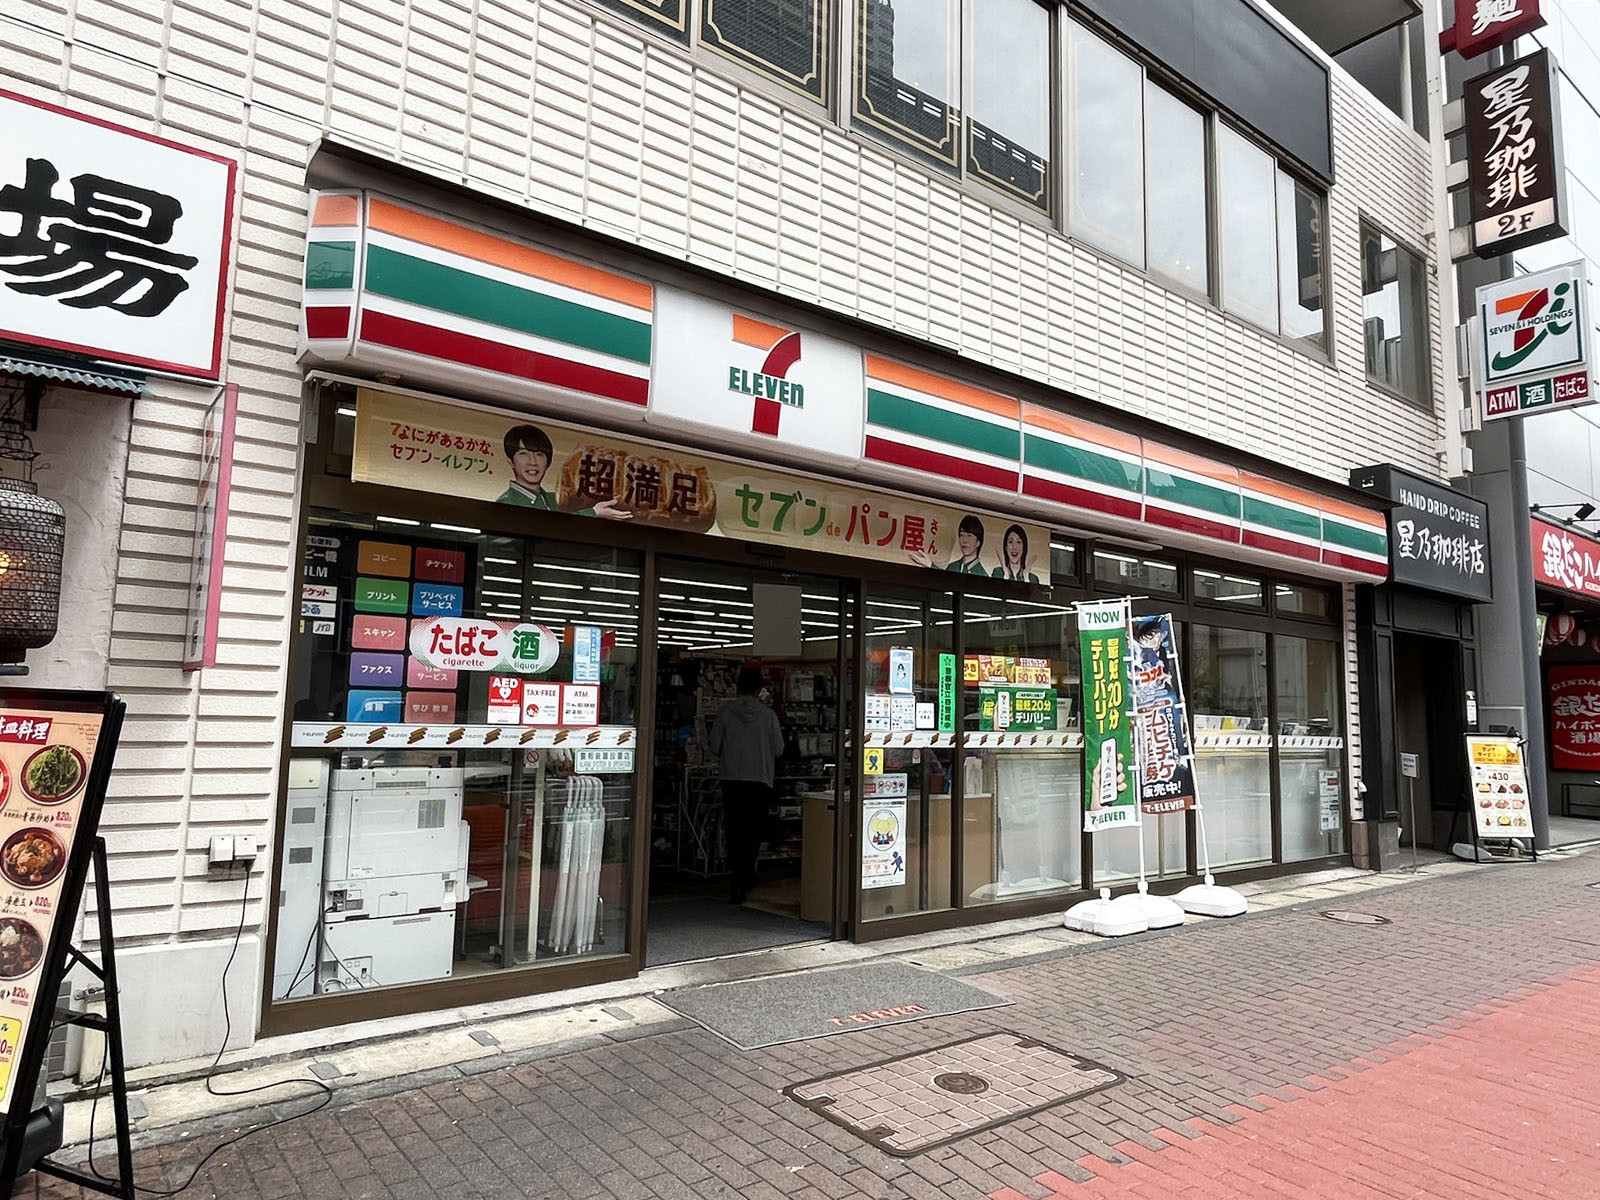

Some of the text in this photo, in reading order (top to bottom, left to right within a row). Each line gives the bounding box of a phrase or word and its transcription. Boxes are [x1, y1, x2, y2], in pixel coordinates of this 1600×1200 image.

[1480, 65, 1537, 207] 星乃珈琲
[1497, 212, 1534, 238] 2F
[0, 157, 199, 318] 場
[1489, 322, 1516, 336] SEVEN
[1527, 308, 1574, 327] HOLDINGS
[1525, 383, 1546, 405] 酒
[1555, 376, 1588, 399] たばこ
[1489, 390, 1517, 412] ATM
[576, 454, 700, 516] 超満足
[1399, 488, 1480, 529] HAND DRIP COFFEE
[1396, 519, 1485, 579] 星乃珈琲店
[1541, 530, 1600, 590] 銀だこハ
[366, 591, 398, 602] プリント
[421, 600, 454, 611] サービス
[1085, 610, 1120, 624] 7NOW
[363, 627, 397, 638] スキャン
[429, 624, 499, 656] たばこ
[512, 629, 541, 660] 酒
[360, 664, 394, 675] ファクス
[442, 657, 486, 668] cigarette
[513, 660, 541, 671] liquor
[416, 672, 449, 682] サービス
[492, 677, 519, 689] AED
[1090, 638, 1107, 735] デリバリー
[1551, 679, 1600, 691] GINDA
[573, 690, 589, 698] ATM
[1015, 712, 1051, 723] デリバリー
[0, 717, 49, 741] 皿料理
